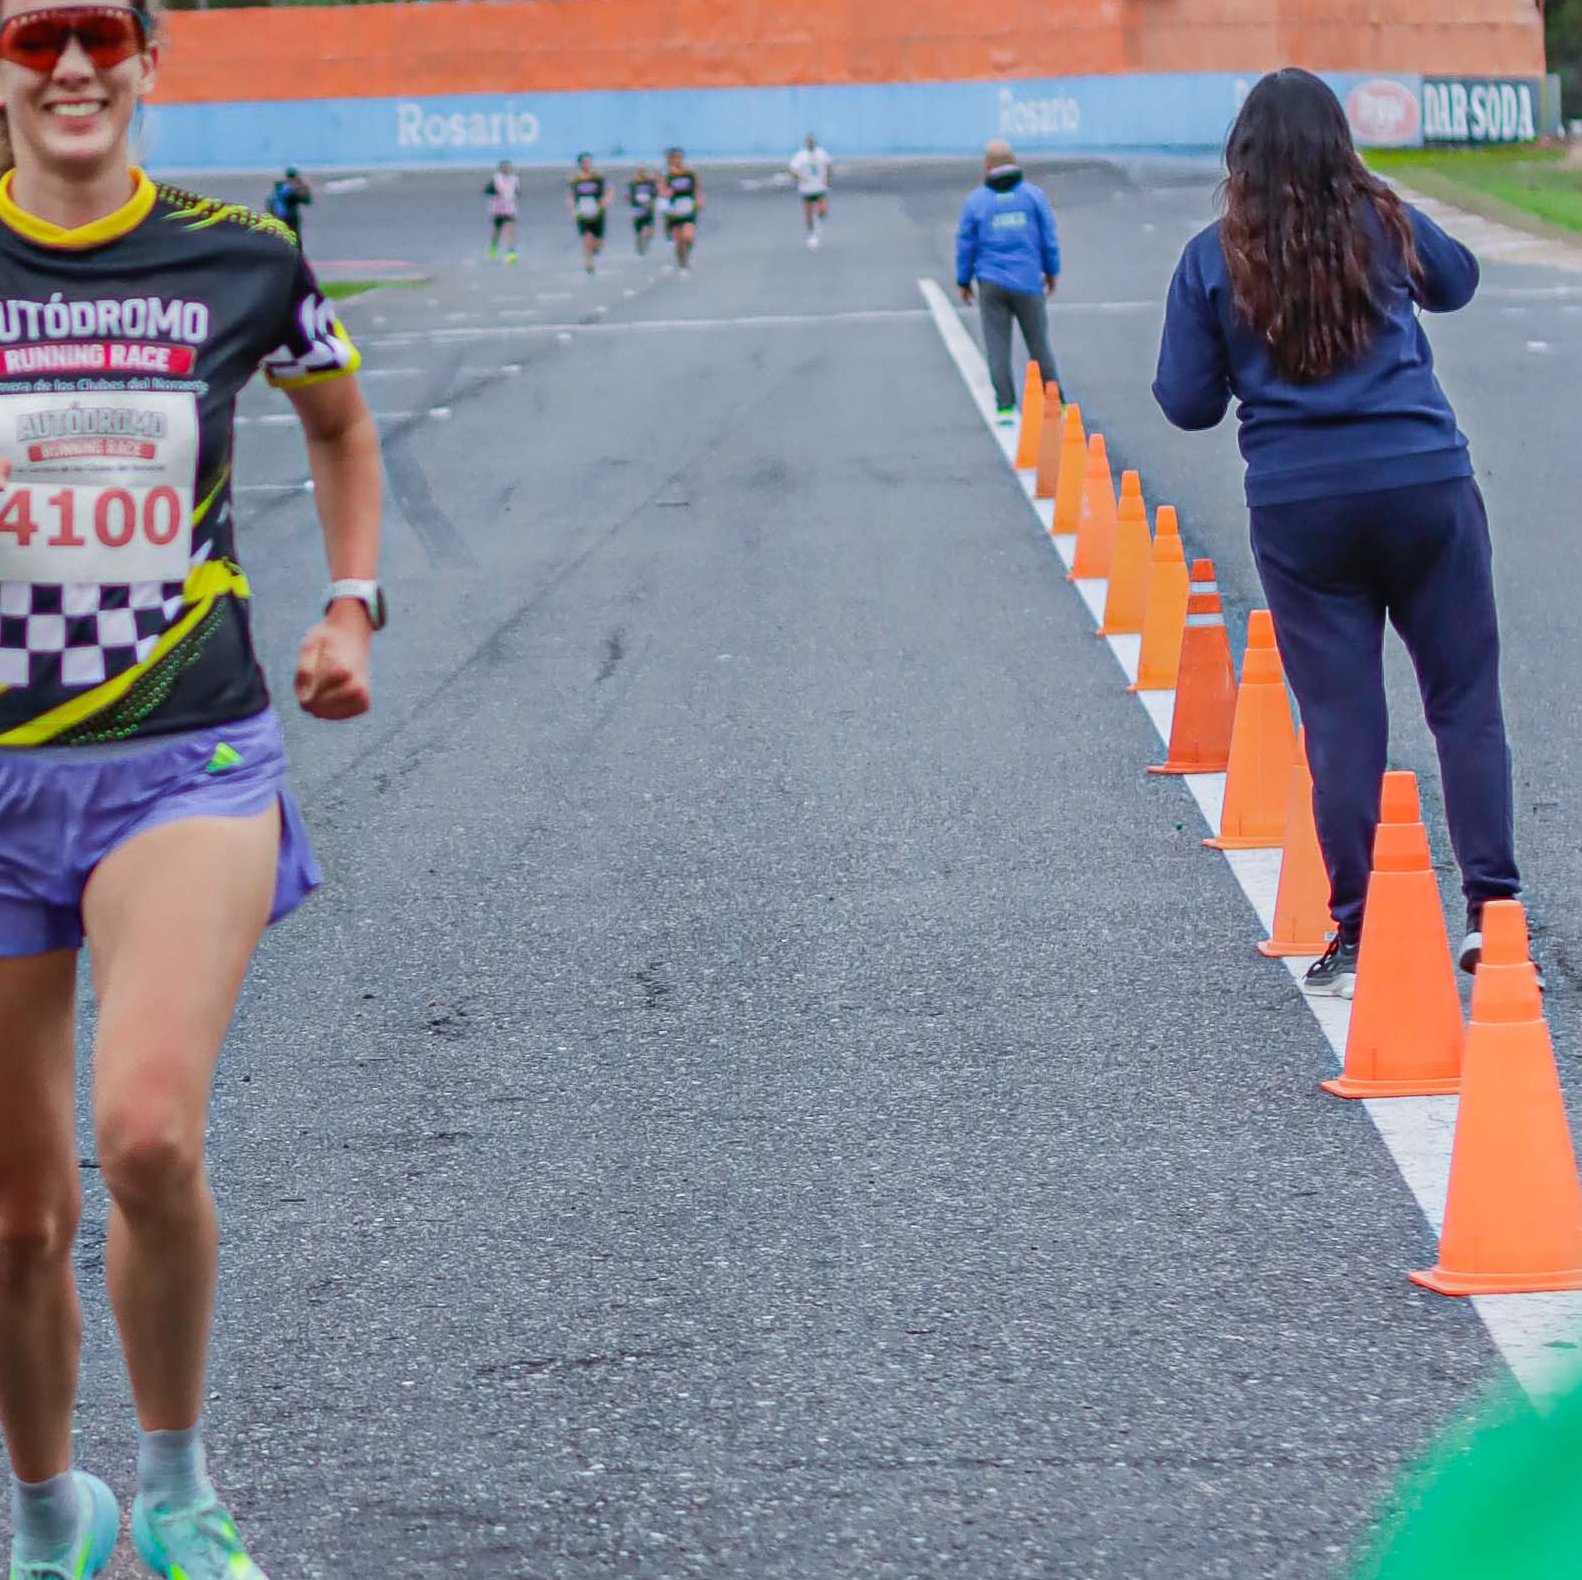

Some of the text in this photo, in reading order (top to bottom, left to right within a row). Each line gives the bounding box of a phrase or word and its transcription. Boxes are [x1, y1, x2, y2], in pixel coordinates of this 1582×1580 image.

[397, 101, 539, 148] Rosario
[4, 343, 171, 374] RUNNING RACE
[33, 378, 52, 391] de
[17, 402, 168, 442] AUTÓDROMO
